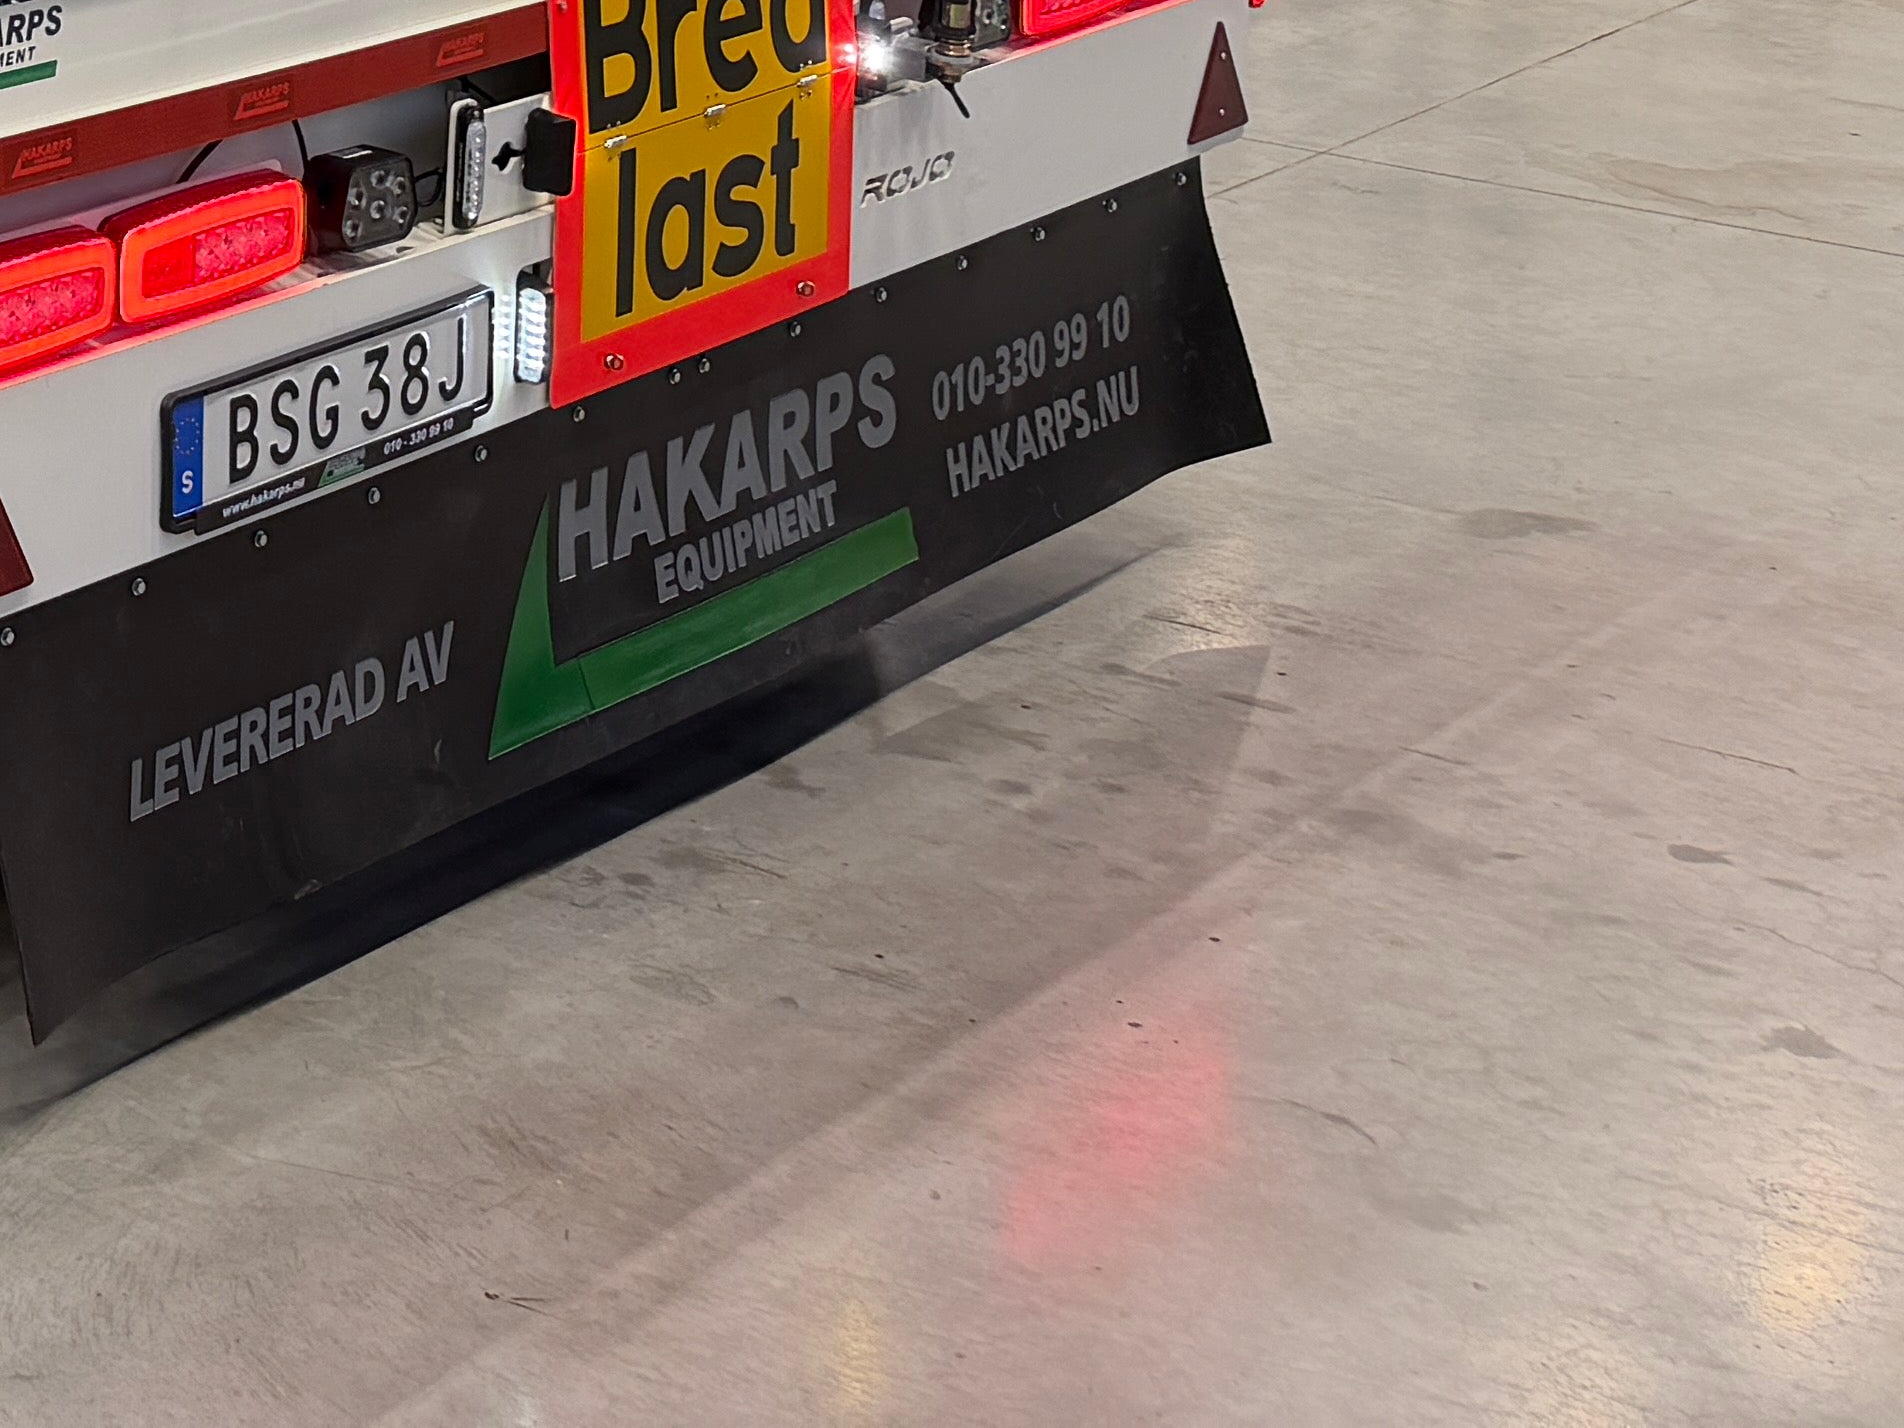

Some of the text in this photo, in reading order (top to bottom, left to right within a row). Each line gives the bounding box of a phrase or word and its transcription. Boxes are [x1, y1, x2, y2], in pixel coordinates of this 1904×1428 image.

[21, 137, 73, 162] HAKARPS
[615, 98, 800, 318] last
[859, 149, 955, 208] ROJO
[181, 316, 467, 495] S BSG 38J
[932, 295, 1130, 421] 010-330 99 10
[558, 353, 897, 583] HAKARPS
[945, 364, 1140, 499] HAKARPS.NU
[222, 476, 308, 519] www.hakarps.nu
[653, 479, 837, 604] EQUIPMENT
[129, 619, 455, 823] LEVERERAD AV
